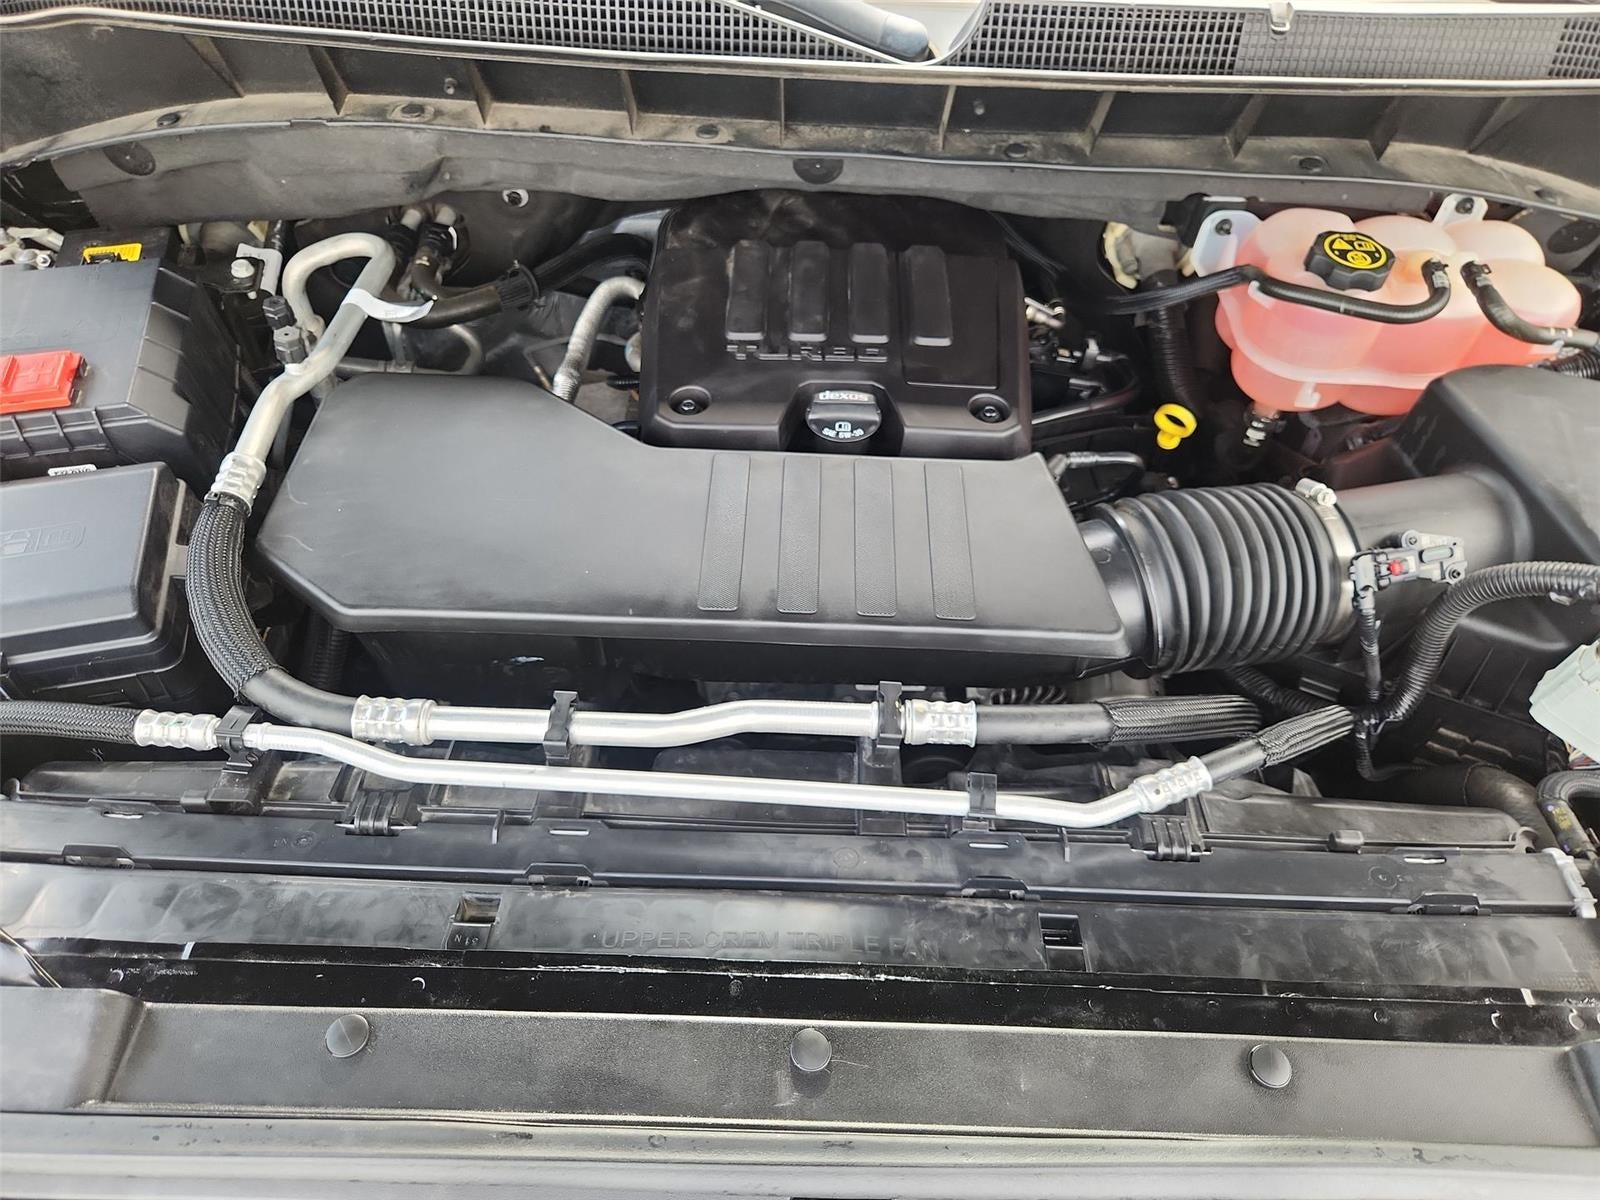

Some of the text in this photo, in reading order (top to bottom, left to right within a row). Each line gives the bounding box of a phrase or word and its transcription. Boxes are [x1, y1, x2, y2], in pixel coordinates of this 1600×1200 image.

[818, 390, 868, 401] dexos
[602, 929, 694, 949] UPPER
[787, 931, 881, 954] TRIPLE
